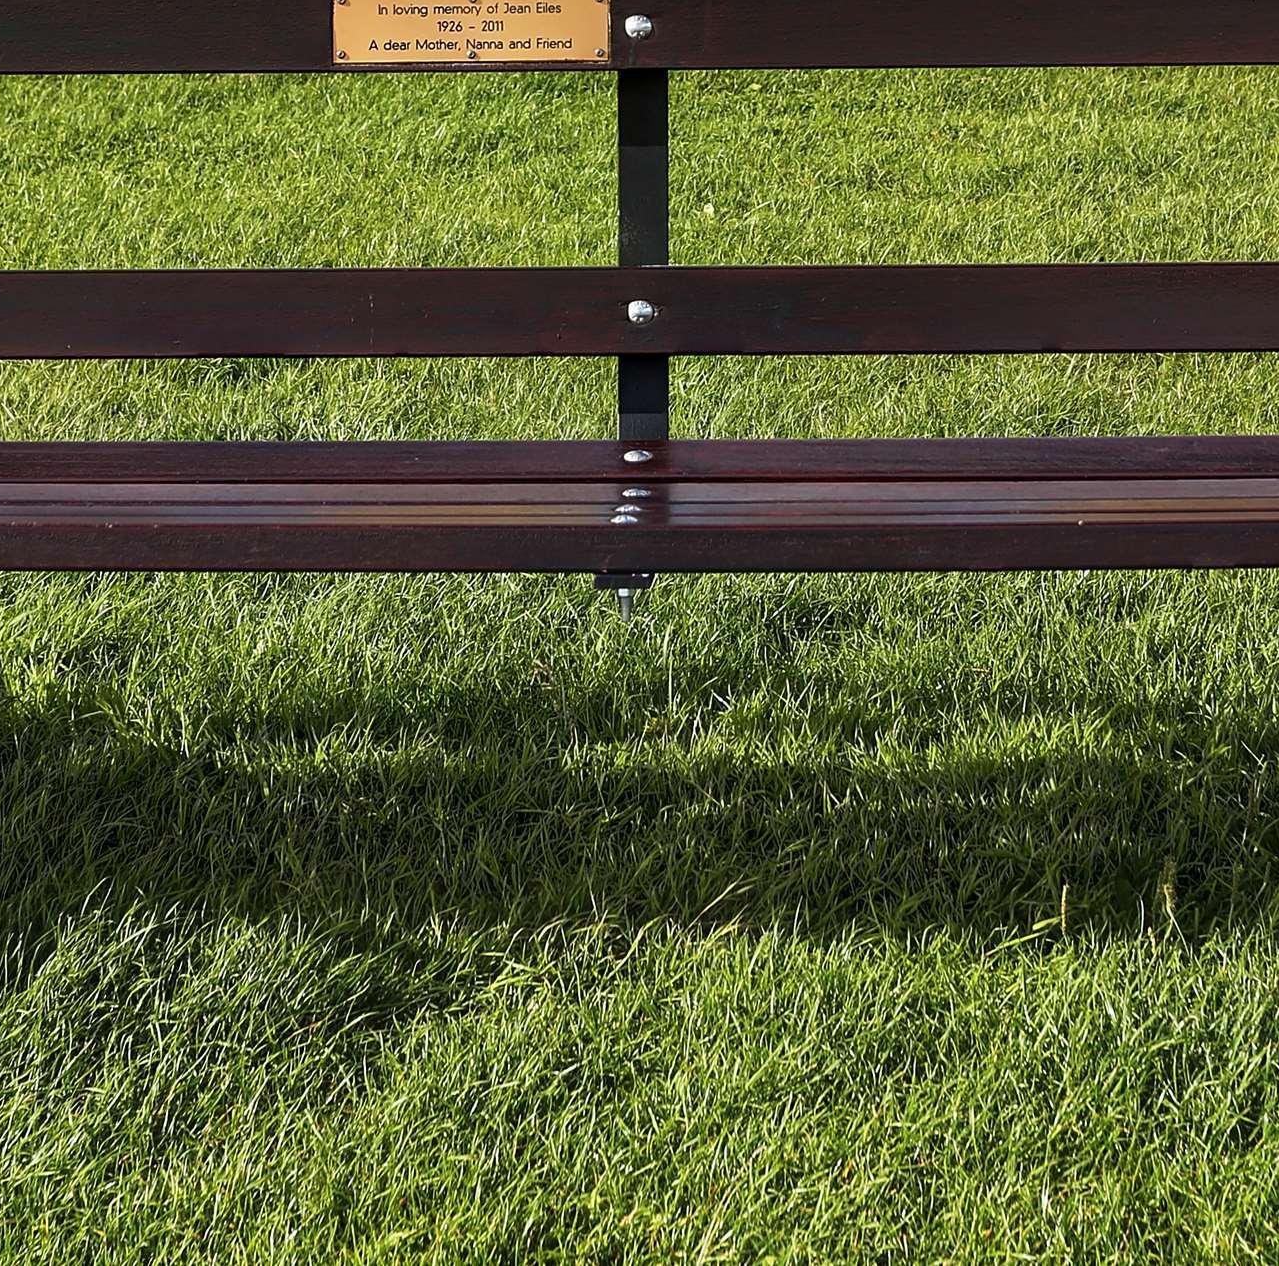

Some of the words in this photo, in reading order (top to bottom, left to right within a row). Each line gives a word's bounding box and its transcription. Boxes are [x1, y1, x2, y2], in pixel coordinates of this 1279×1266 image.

[378, 4, 388, 15] In
[393, 4, 428, 17] loving
[433, 4, 481, 16] memory
[487, 2, 499, 14] of
[503, 3, 531, 14] Jean
[536, 3, 561, 13] Eiles
[437, 21, 463, 32] 1926
[481, 20, 504, 31] 2011
[369, 40, 378, 51] A
[384, 39, 410, 50] dear
[415, 39, 461, 51] Mother,
[466, 39, 503, 50] Nanna
[509, 38, 531, 49] and
[536, 38, 572, 49] Friend
